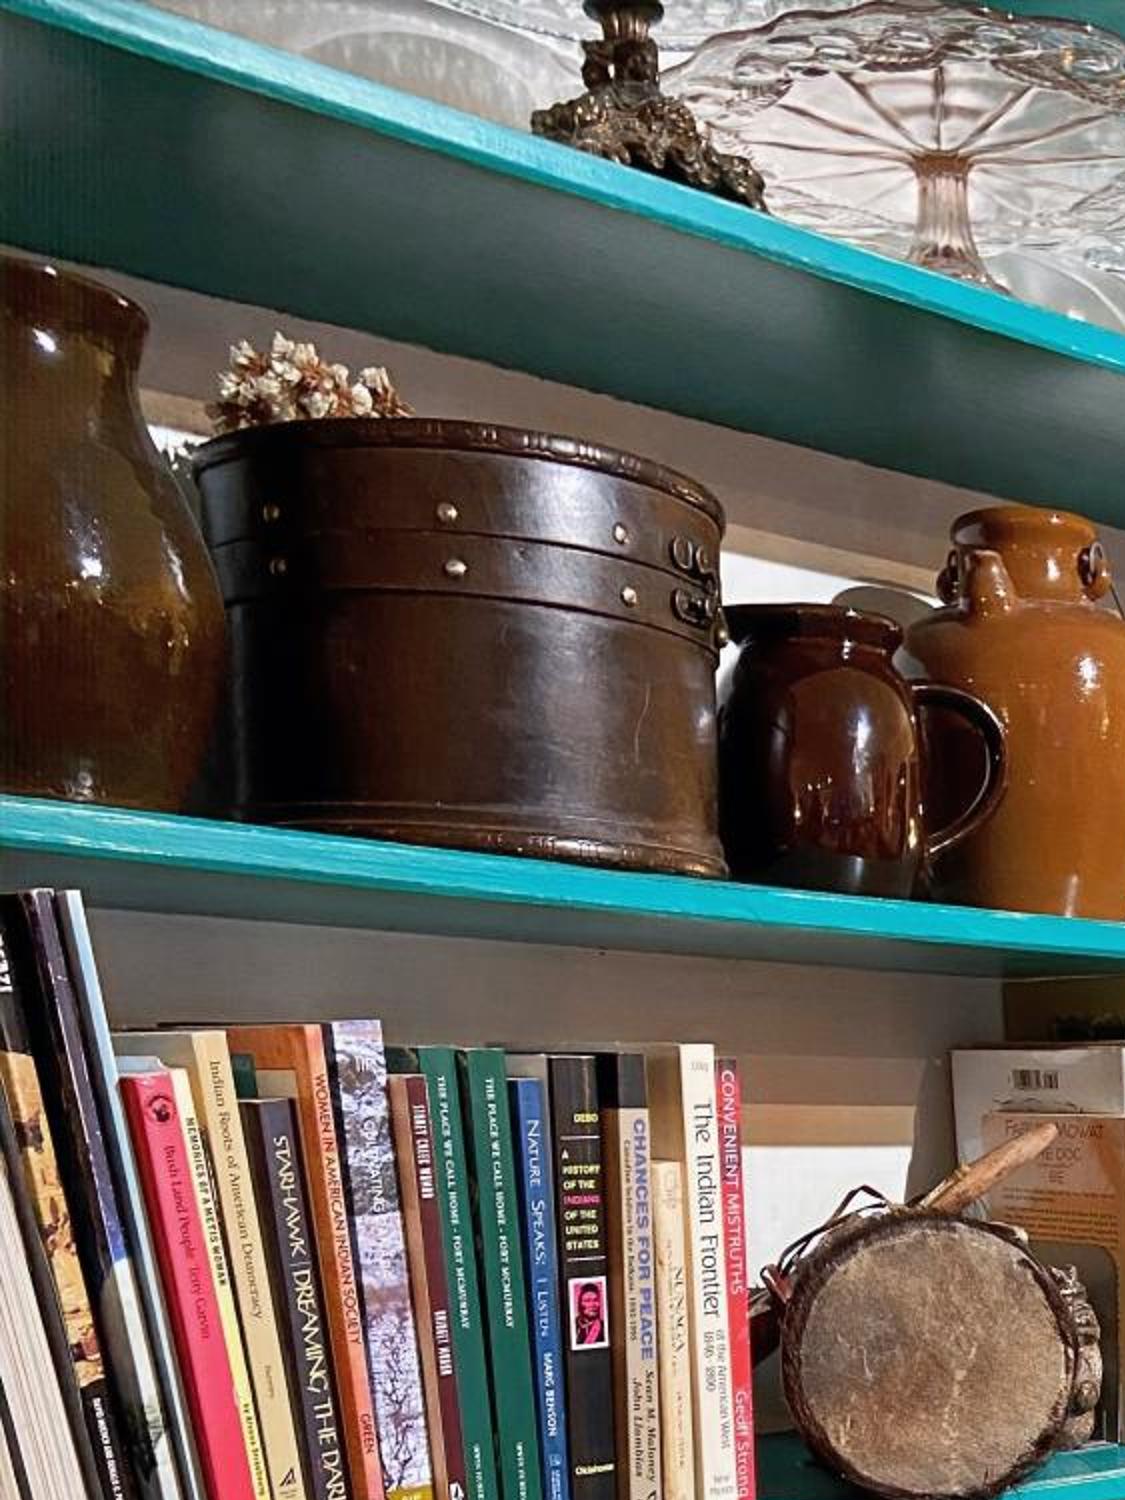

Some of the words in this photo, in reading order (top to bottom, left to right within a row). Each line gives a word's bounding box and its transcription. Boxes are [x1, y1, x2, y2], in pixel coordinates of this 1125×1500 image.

[209, 1060, 227, 1108] Indian
[312, 1073, 333, 1133] WOMEN
[436, 1075, 447, 1100] THE
[485, 1077, 495, 1101] THE
[216, 1111, 234, 1152] Roots
[440, 1102, 451, 1138] PLACE
[487, 1103, 500, 1138] PLACE
[693, 1100, 713, 1143] The
[720, 1069, 739, 1186] CONVENIENT
[226, 1155, 240, 1170] of
[322, 1136, 336, 1151] IN
[561, 1149, 569, 1160] A
[363, 1119, 386, 1213] CULTIVATING
[446, 1160, 456, 1189] CALL
[493, 1161, 504, 1187] CALL
[562, 1165, 601, 1176] HISTORY
[563, 1180, 577, 1191] OF
[578, 1179, 596, 1190] THE
[632, 1118, 650, 1230] CHANCES
[228, 1172, 249, 1240] American
[272, 1135, 307, 1258] STARHAWK
[325, 1156, 346, 1231] AMERICAN
[448, 1191, 460, 1226] HOME
[495, 1191, 507, 1227] HOME
[697, 1154, 716, 1224] Indian
[564, 1210, 578, 1221] OF
[580, 1209, 598, 1220] THE
[565, 1224, 599, 1236] UNITED
[204, 1207, 219, 1243] METIS
[212, 1245, 227, 1288] WOMAN
[336, 1234, 353, 1286] INDIAN
[566, 1239, 600, 1251] STATES
[637, 1235, 652, 1281] FOR
[727, 1192, 744, 1296] MISTRUTHS
[240, 1242, 264, 1320] Democracy
[501, 1267, 514, 1329] MCMURRAY
[702, 1234, 721, 1319] Frontier
[343, 1288, 361, 1345] SOCIETY
[639, 1287, 654, 1361] PEACE
[291, 1268, 327, 1394] DREAMING
[314, 1396, 337, 1445] THE
[545, 1389, 558, 1437] BENSON
[633, 1377, 644, 1412] John
[717, 1365, 731, 1420] American
[360, 1412, 375, 1455] GREEN
[721, 1422, 732, 1450] West
